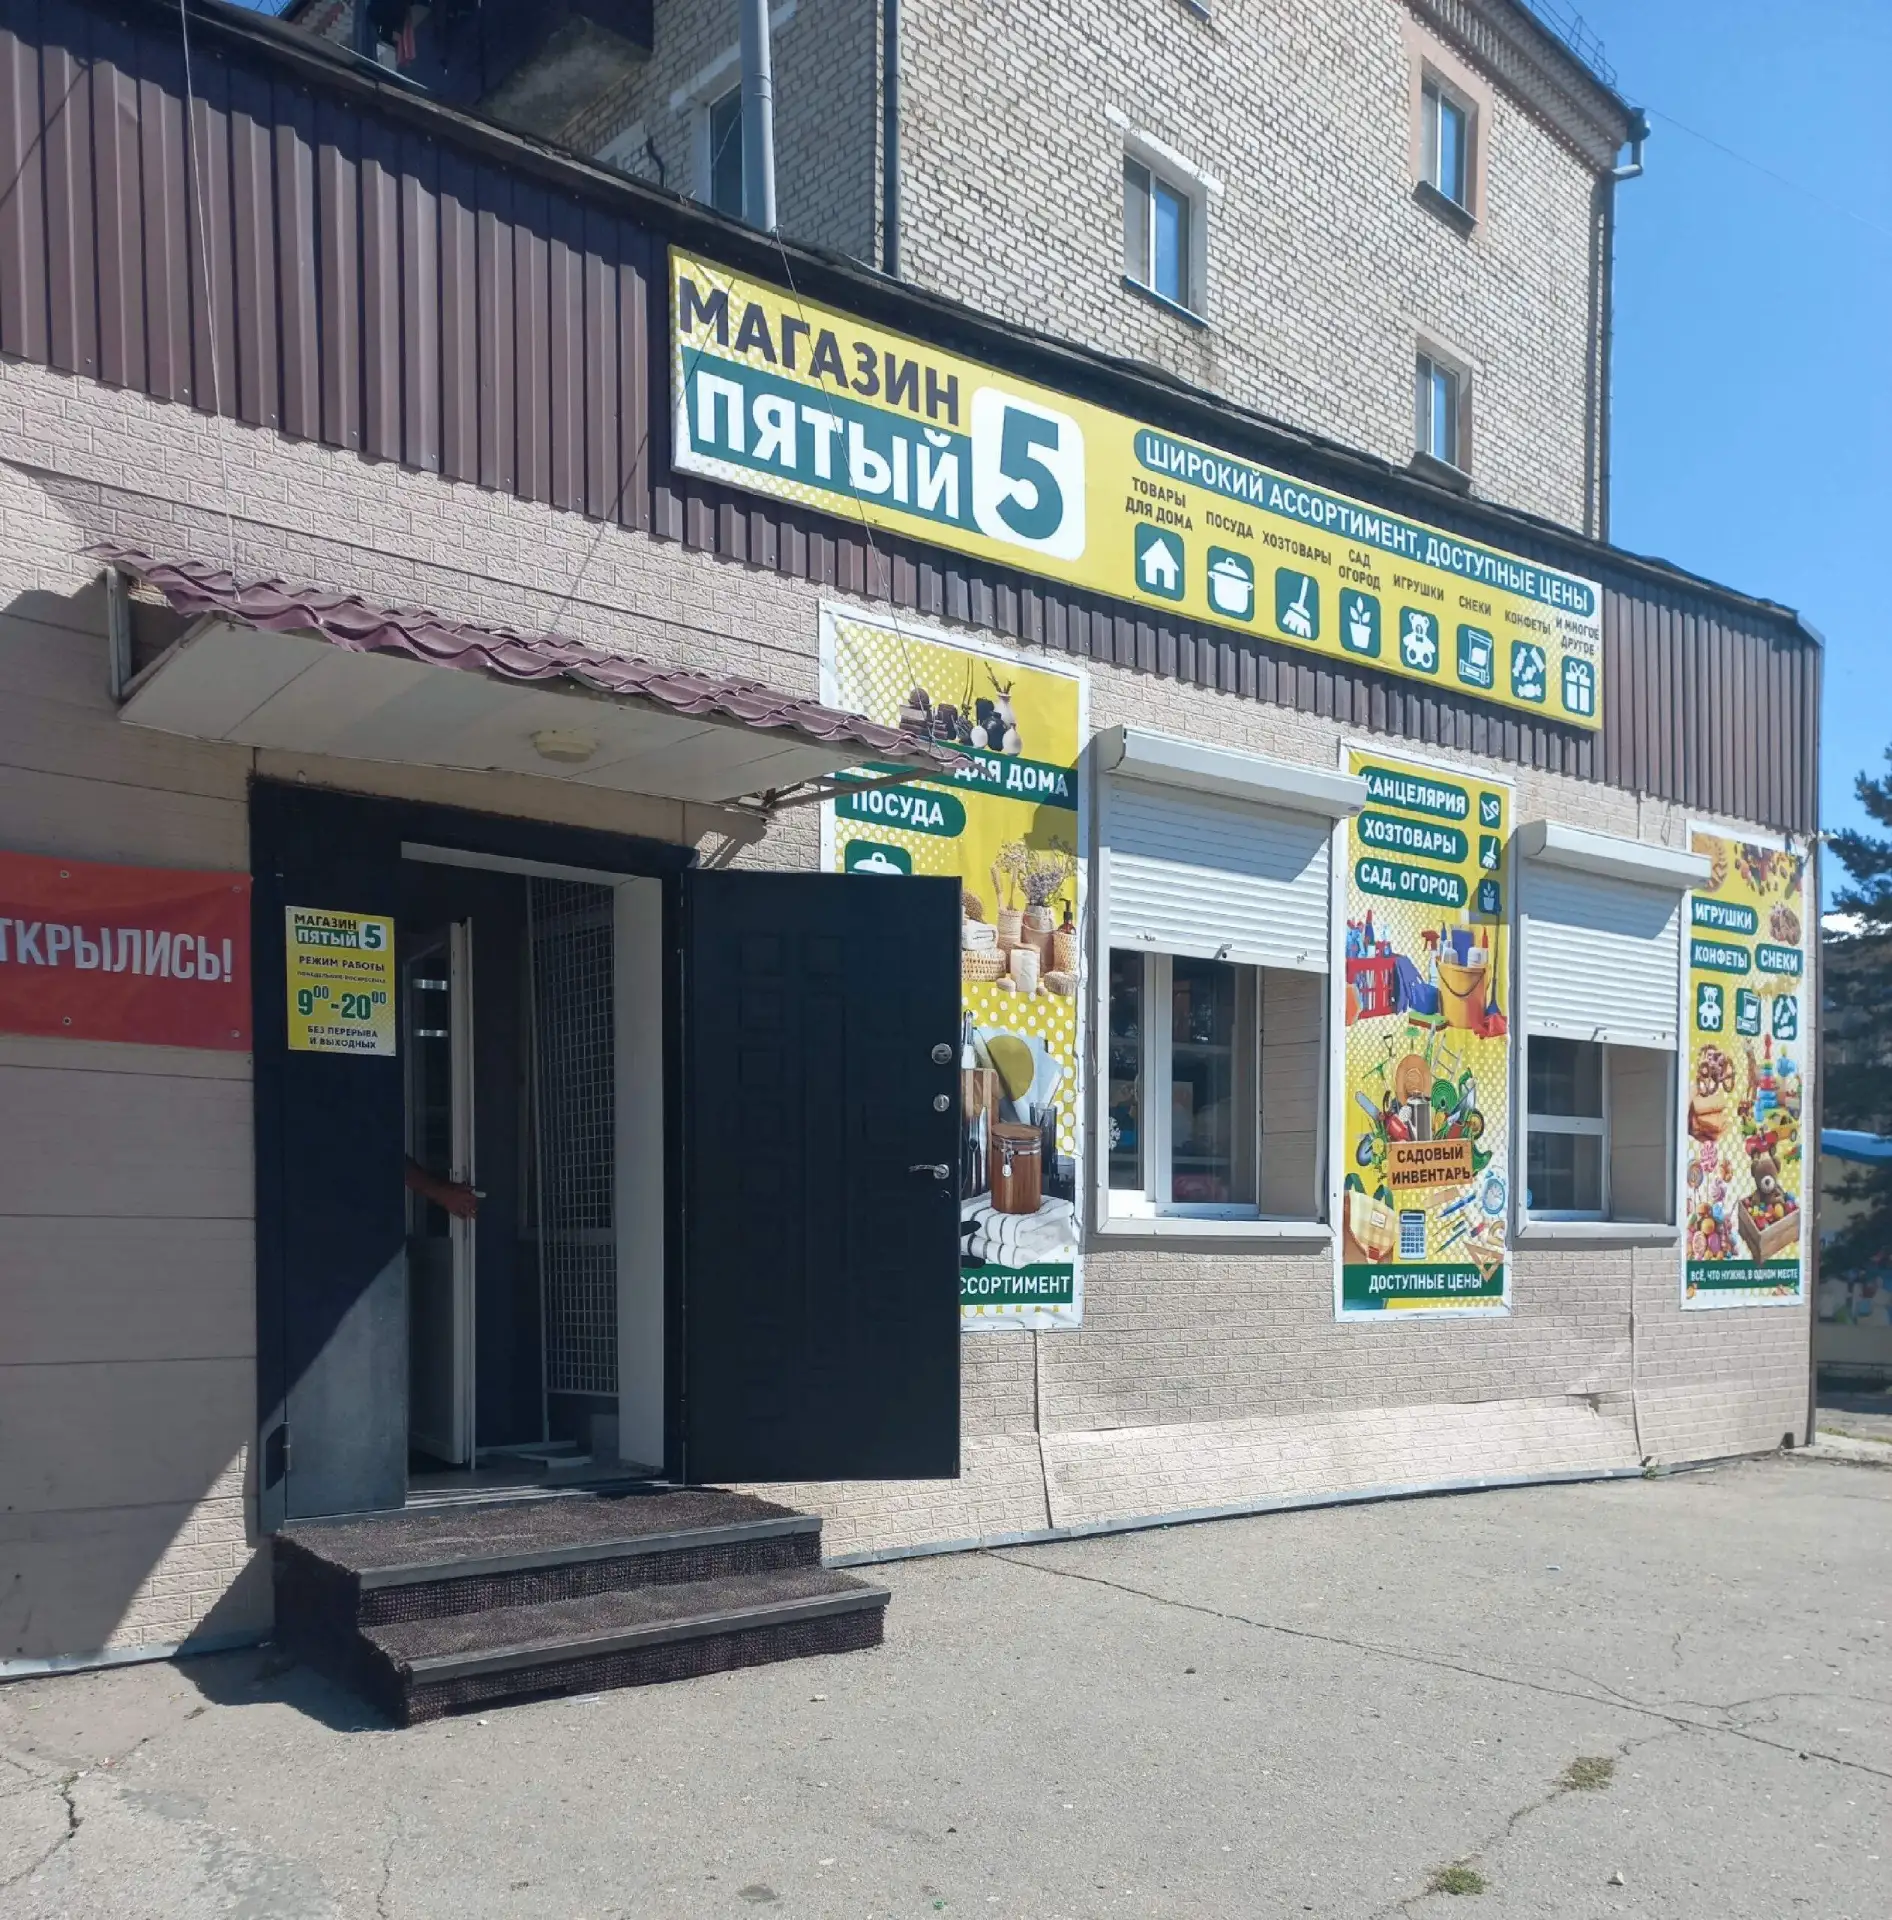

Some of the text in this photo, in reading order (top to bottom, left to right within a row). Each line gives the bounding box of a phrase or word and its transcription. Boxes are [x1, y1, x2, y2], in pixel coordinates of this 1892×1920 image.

[679, 276, 959, 427] МАГАЗИН
[696, 369, 959, 520] ПЯТЫЙ
[994, 405, 1064, 540] 5
[1132, 476, 1186, 508] ТОВАРЫ
[1125, 496, 1193, 531] ДЛЯ ДОМА
[1145, 436, 1589, 612] ШИРОКИЙ АССОРТИМЕНТ, ДОСТУПНЫЕ ЦЕНЫ
[1206, 511, 1254, 539] ПОСУДА
[1262, 531, 1332, 566] ХОЗТОВАРЫ
[1348, 549, 1371, 569] САД
[1338, 565, 1381, 592] ОГОРОД
[1393, 574, 1445, 601] ИГРУШКИ
[1458, 595, 1492, 617] СНЕКИ
[1504, 610, 1551, 636] КОНФЕТЫ
[1556, 618, 1563, 629] И
[1561, 636, 1595, 656] ДРУГОЕ
[1005, 763, 1069, 798] ДОМА
[851, 790, 945, 827] ПОСУДА
[1364, 818, 1456, 855] ХОЗТОВАРЫ
[1360, 863, 1459, 903] САД, ОГОРОД
[294, 913, 357, 930] МАГАЗИН
[1694, 902, 1753, 931] ИГРУШКИ
[298, 928, 357, 947] ПЯТЫЙ
[364, 924, 382, 949] 5
[0, 917, 232, 982] ТКРЫЛИСЬ!
[1694, 944, 1748, 969] КОНФЕТЫ
[1760, 949, 1798, 972] СНЕКИ
[299, 955, 385, 972] РЕЖИМ РАБОТЫ
[307, 1025, 378, 1038] БЕЗ ПЕРЕРЫВА
[309, 1037, 376, 1049] И ВЫХОДНЫХ
[1396, 1143, 1464, 1165] САДОВЫЙ
[1391, 1166, 1471, 1185] ИНВЕНТАРЬ
[960, 1276, 1071, 1294] ССОРТИМЕНТ
[1368, 1274, 1482, 1293] ДОСТУПНЫЕ ЦЕНЫ
[1707, 1270, 1720, 1280] ЧТО
[1753, 1269, 1776, 1281] ОДНОМ
[1777, 1268, 1798, 1279] МЕСТЕ
